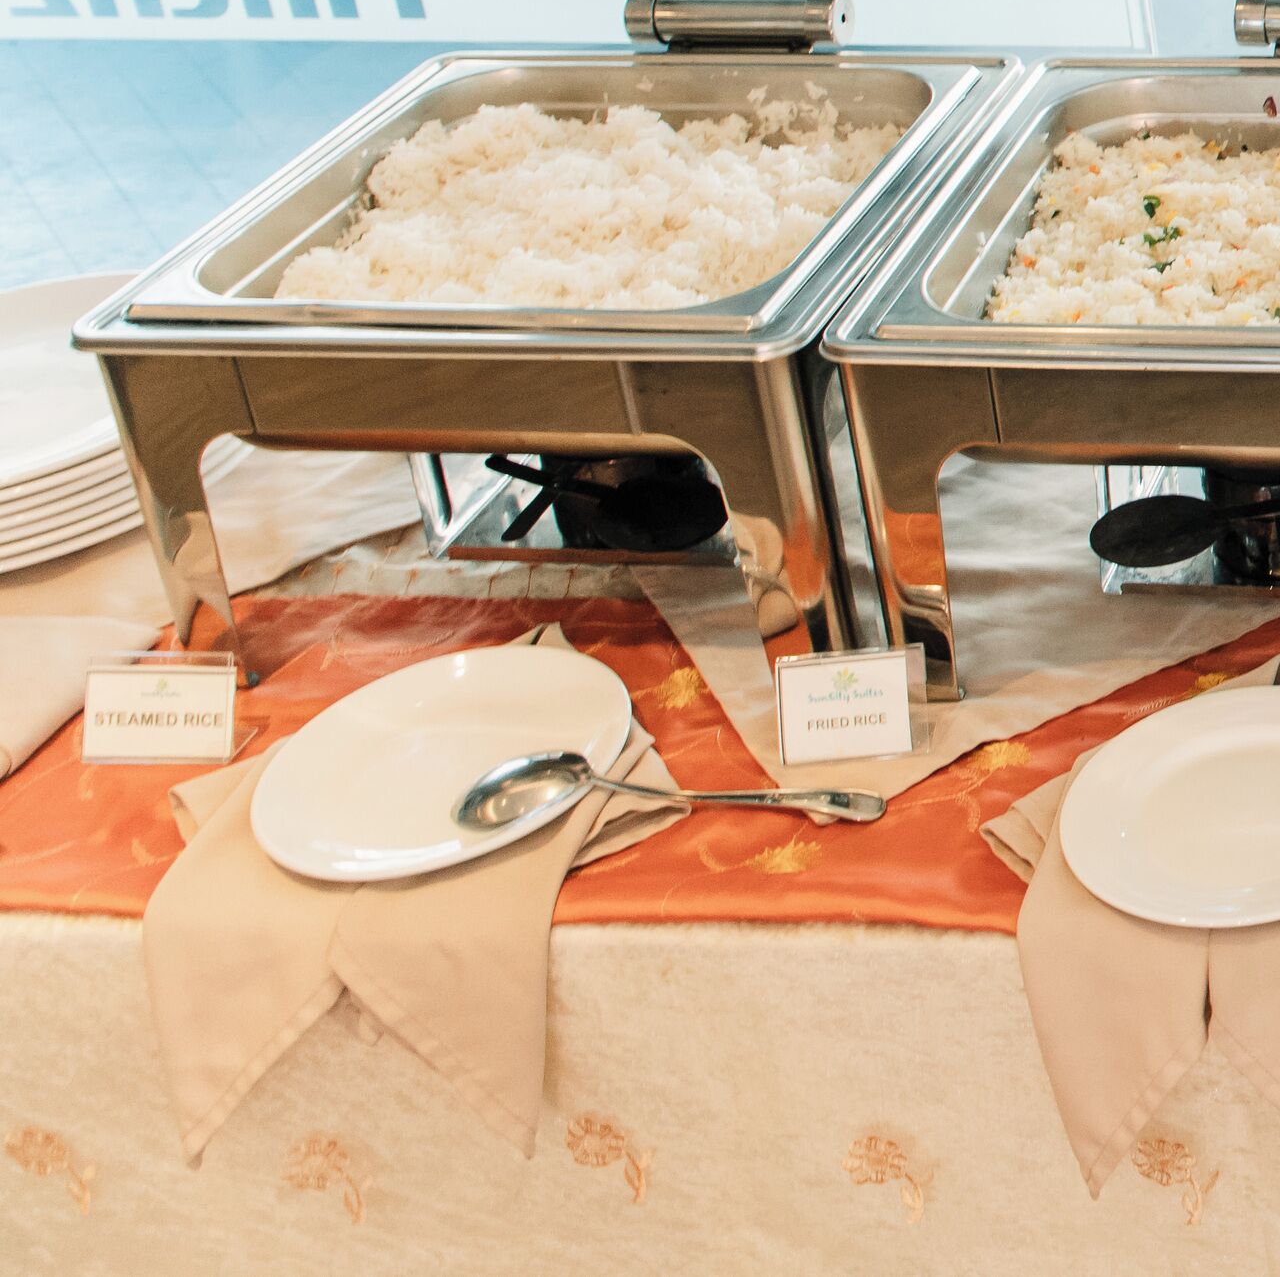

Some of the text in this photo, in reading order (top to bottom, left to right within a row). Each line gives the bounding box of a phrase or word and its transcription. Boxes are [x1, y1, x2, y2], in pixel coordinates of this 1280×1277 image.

[94, 712, 224, 727] STEAMED RICE
[807, 713, 887, 732] FRIED RICE
